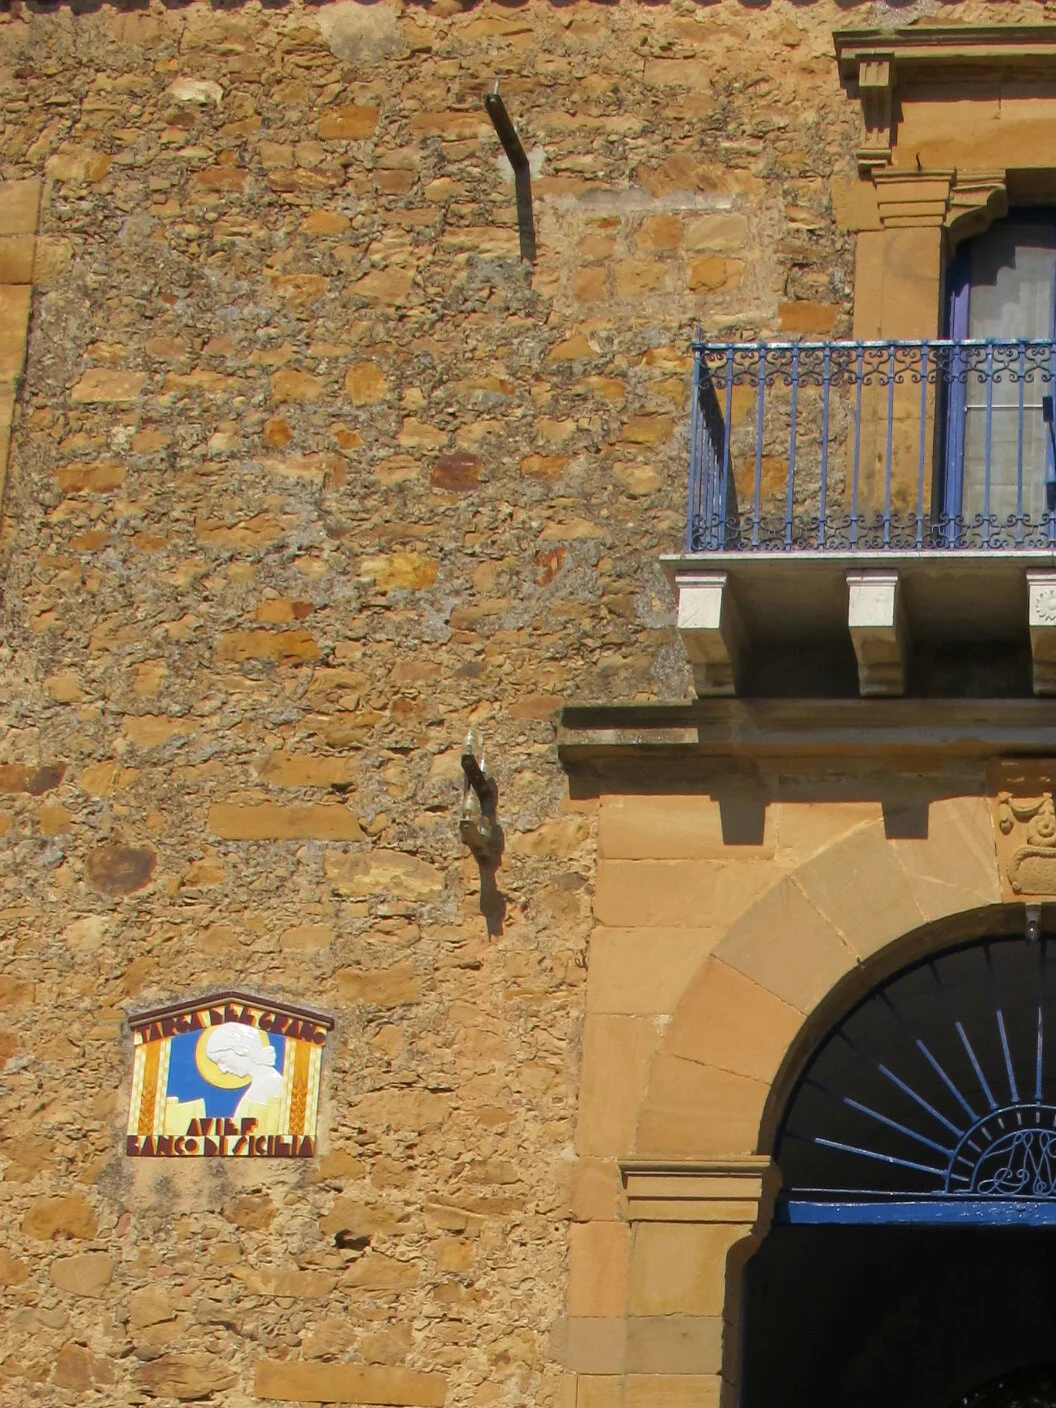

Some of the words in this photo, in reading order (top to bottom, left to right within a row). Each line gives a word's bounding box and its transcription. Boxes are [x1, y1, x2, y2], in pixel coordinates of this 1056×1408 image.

[135, 1012, 206, 1043] TARGA
[209, 1003, 256, 1025] DEL
[259, 1013, 327, 1045] GRANO
[126, 1135, 200, 1156] BANCO
[203, 1136, 228, 1157] DI
[232, 1136, 315, 1157] SICILIA
